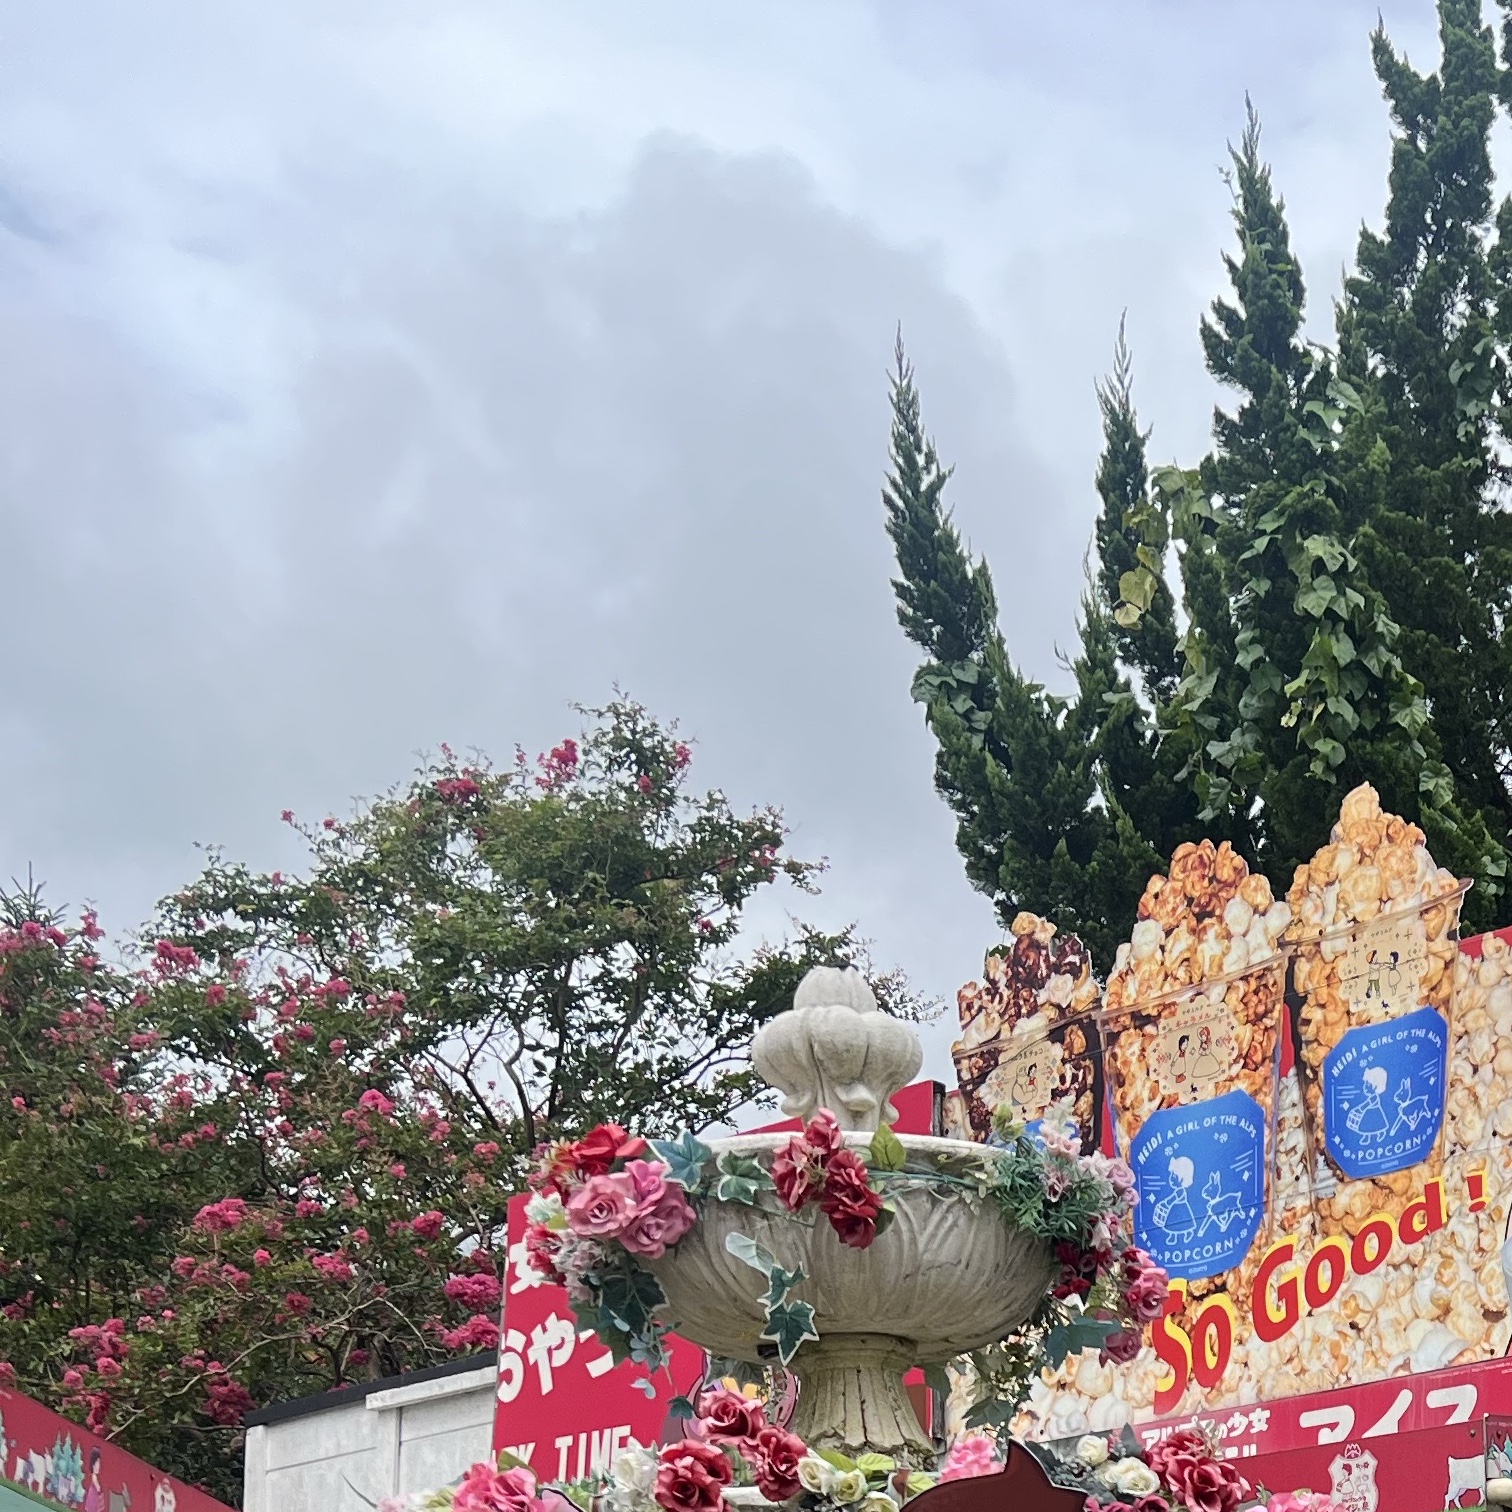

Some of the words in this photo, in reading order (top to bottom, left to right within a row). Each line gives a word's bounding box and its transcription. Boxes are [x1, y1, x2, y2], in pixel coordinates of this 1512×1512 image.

[1331, 1047, 1358, 1078] HEIDI
[1361, 1044, 1369, 1054] A
[1370, 1034, 1394, 1049] GIRL
[1396, 1029, 1409, 1041] OF
[1410, 1028, 1426, 1038] THE
[1427, 1030, 1441, 1049] ALPS
[1137, 1132, 1163, 1165] HEIDI
[1166, 1130, 1174, 1141] A
[1175, 1119, 1201, 1135] GIRL
[1203, 1116, 1218, 1128] OF
[1219, 1114, 1238, 1126] THE
[1238, 1117, 1257, 1139] ALPS
[1357, 1134, 1422, 1161] POPCORN
[1164, 1236, 1234, 1263] POPCORN
